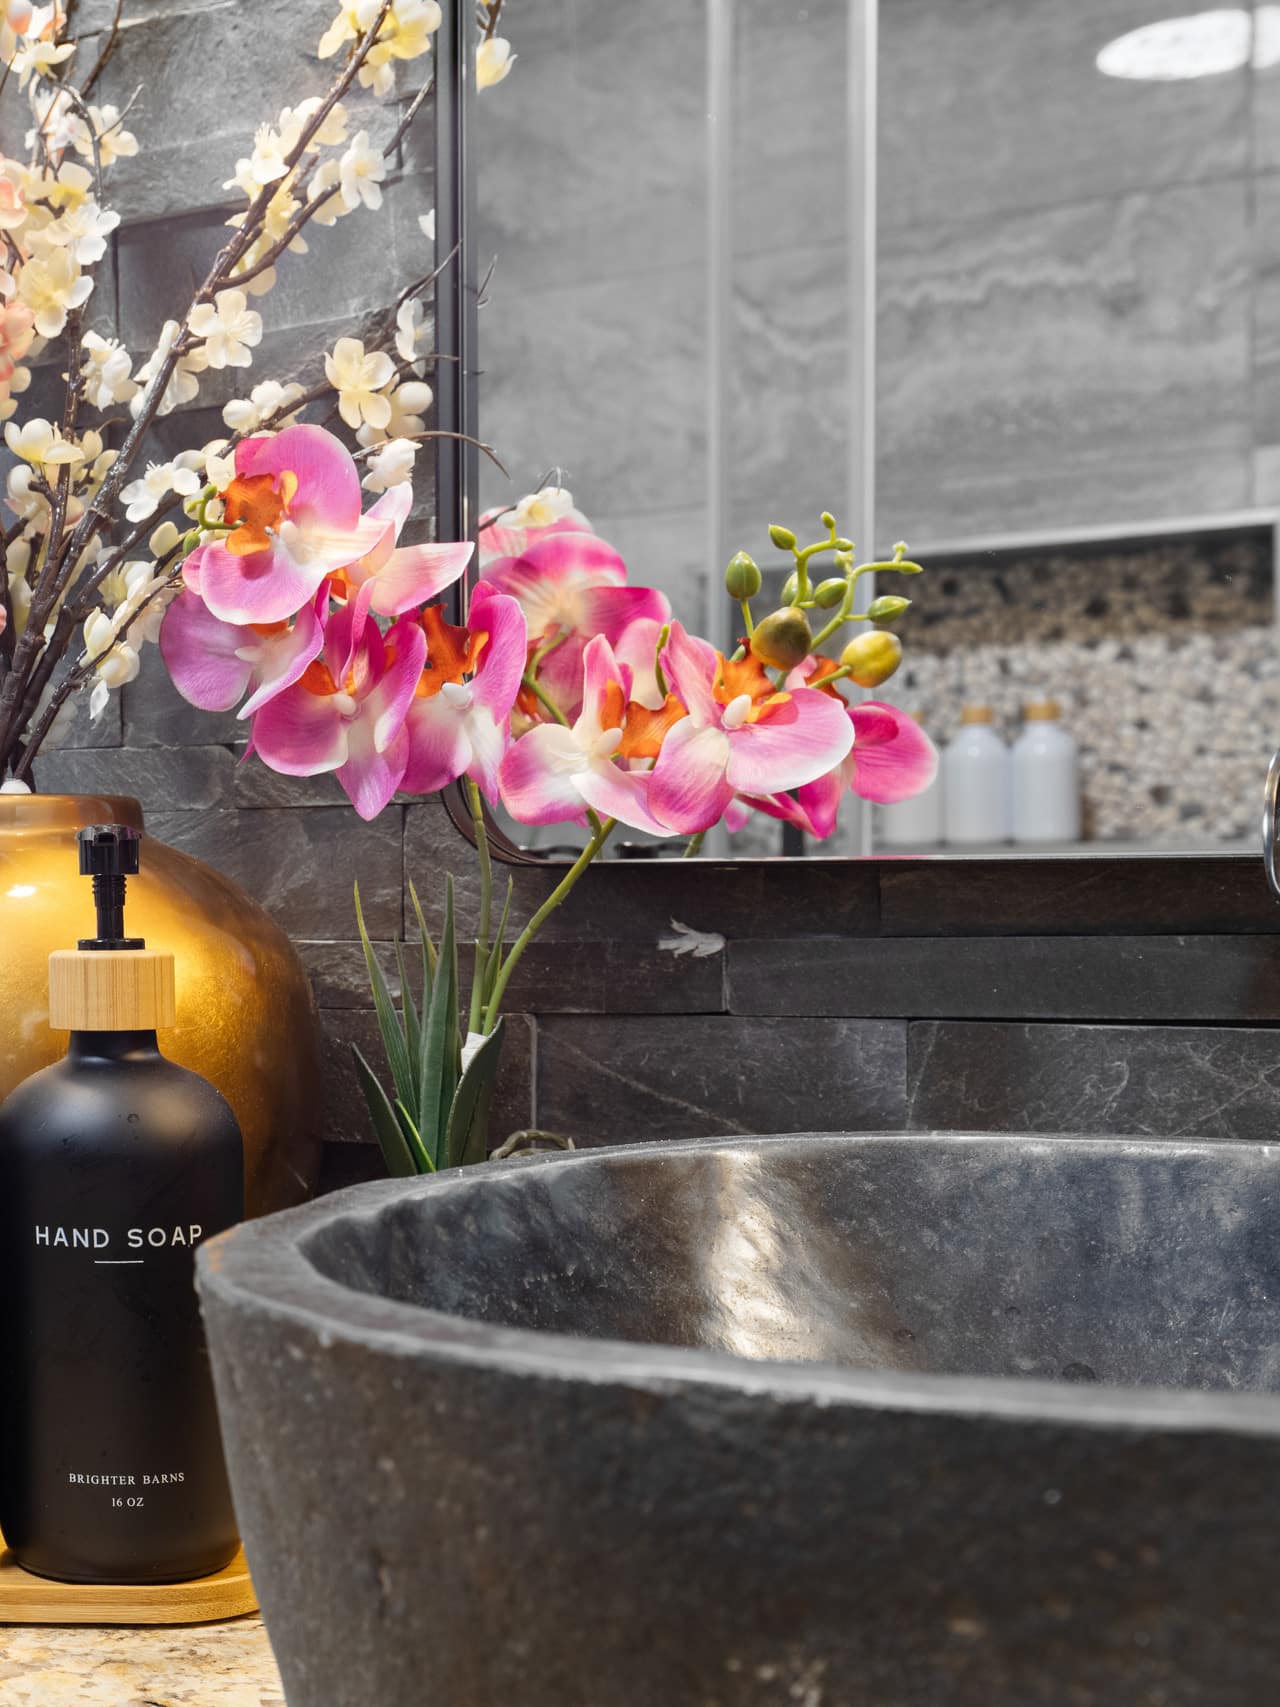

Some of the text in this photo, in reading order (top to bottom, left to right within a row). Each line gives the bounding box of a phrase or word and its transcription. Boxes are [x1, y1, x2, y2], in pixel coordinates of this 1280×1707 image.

[35, 1224, 203, 1249] HAND SOAP
[68, 1472, 185, 1486] BRIGHTER BARNS
[111, 1497, 144, 1508] 16 OZ
